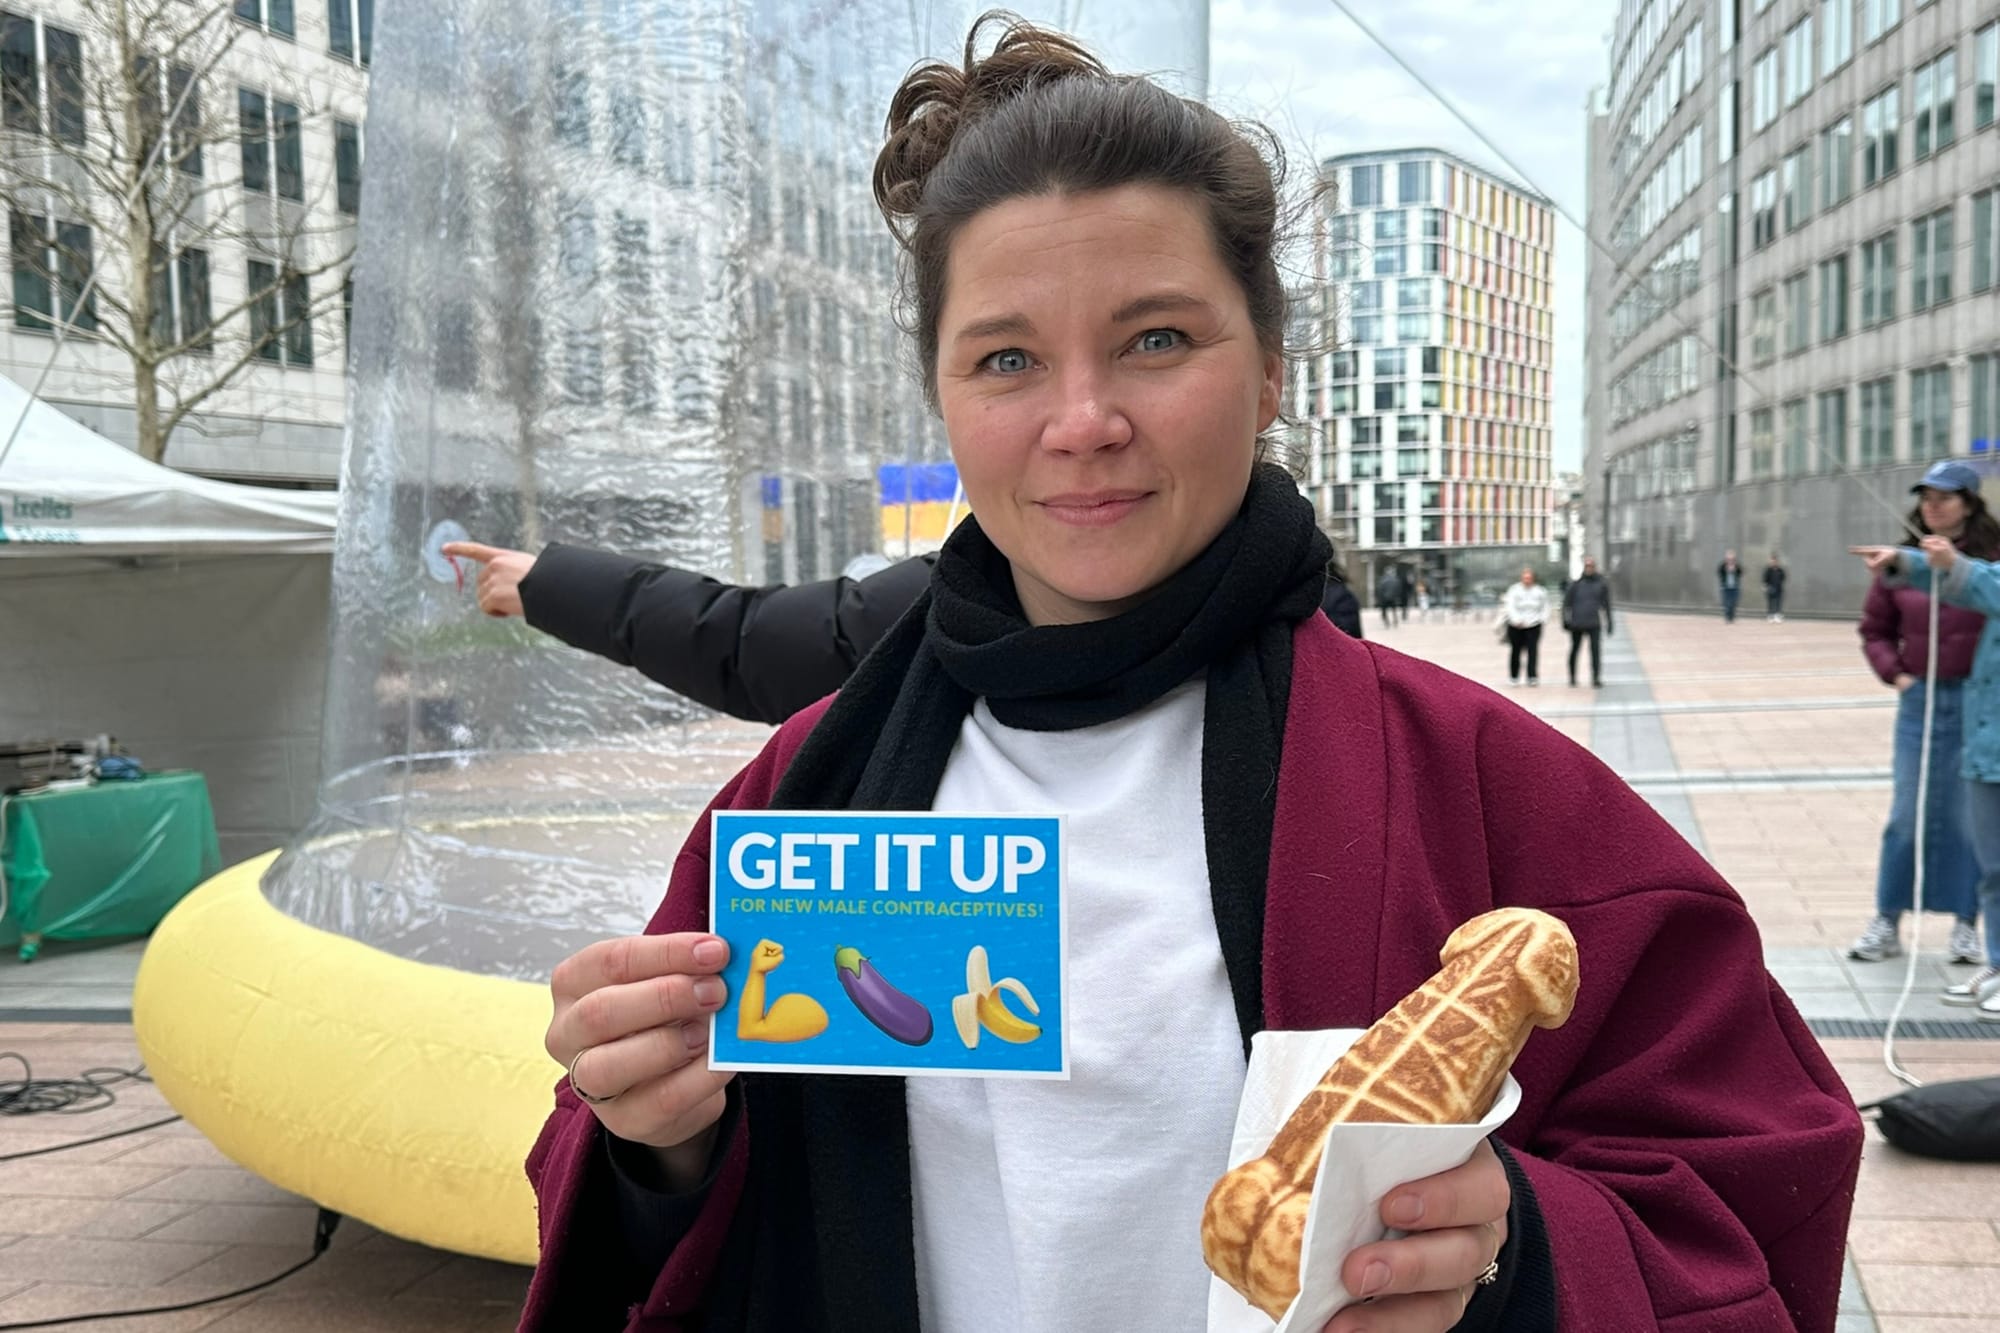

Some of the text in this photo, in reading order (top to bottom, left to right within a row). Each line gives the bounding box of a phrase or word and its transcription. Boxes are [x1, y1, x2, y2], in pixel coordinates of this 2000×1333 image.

[728, 832, 1046, 894] GET IT UP
[730, 898, 1044, 918] FOR NEW MALE CONTRACEPTIVES!
